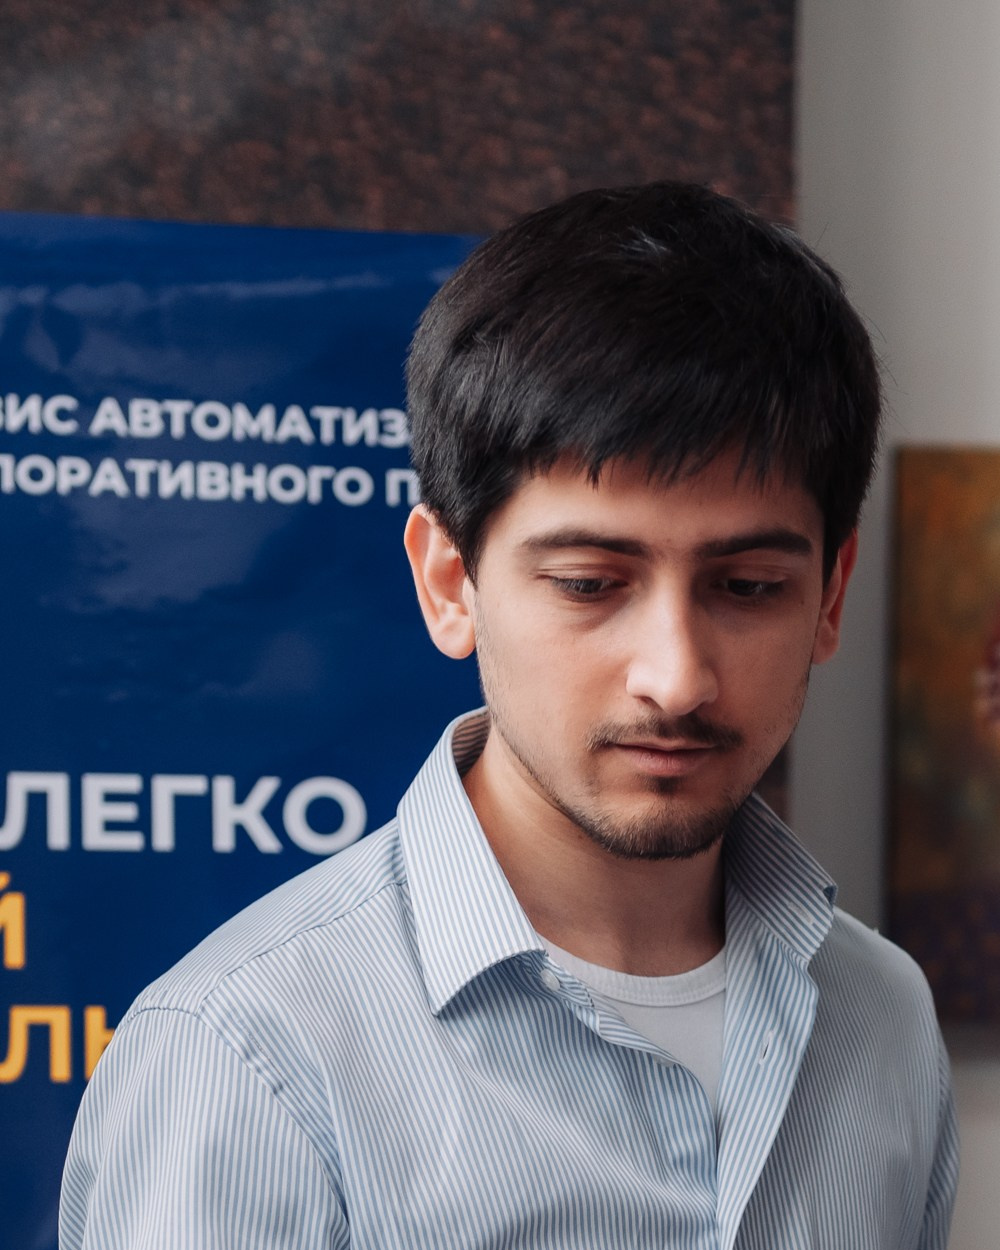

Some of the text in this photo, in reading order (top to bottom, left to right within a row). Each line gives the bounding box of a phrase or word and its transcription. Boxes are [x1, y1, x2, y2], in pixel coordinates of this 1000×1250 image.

[0, 393, 412, 448] ИС АВТОМАТИЗ
[0, 771, 367, 855] ЛЕГКО
